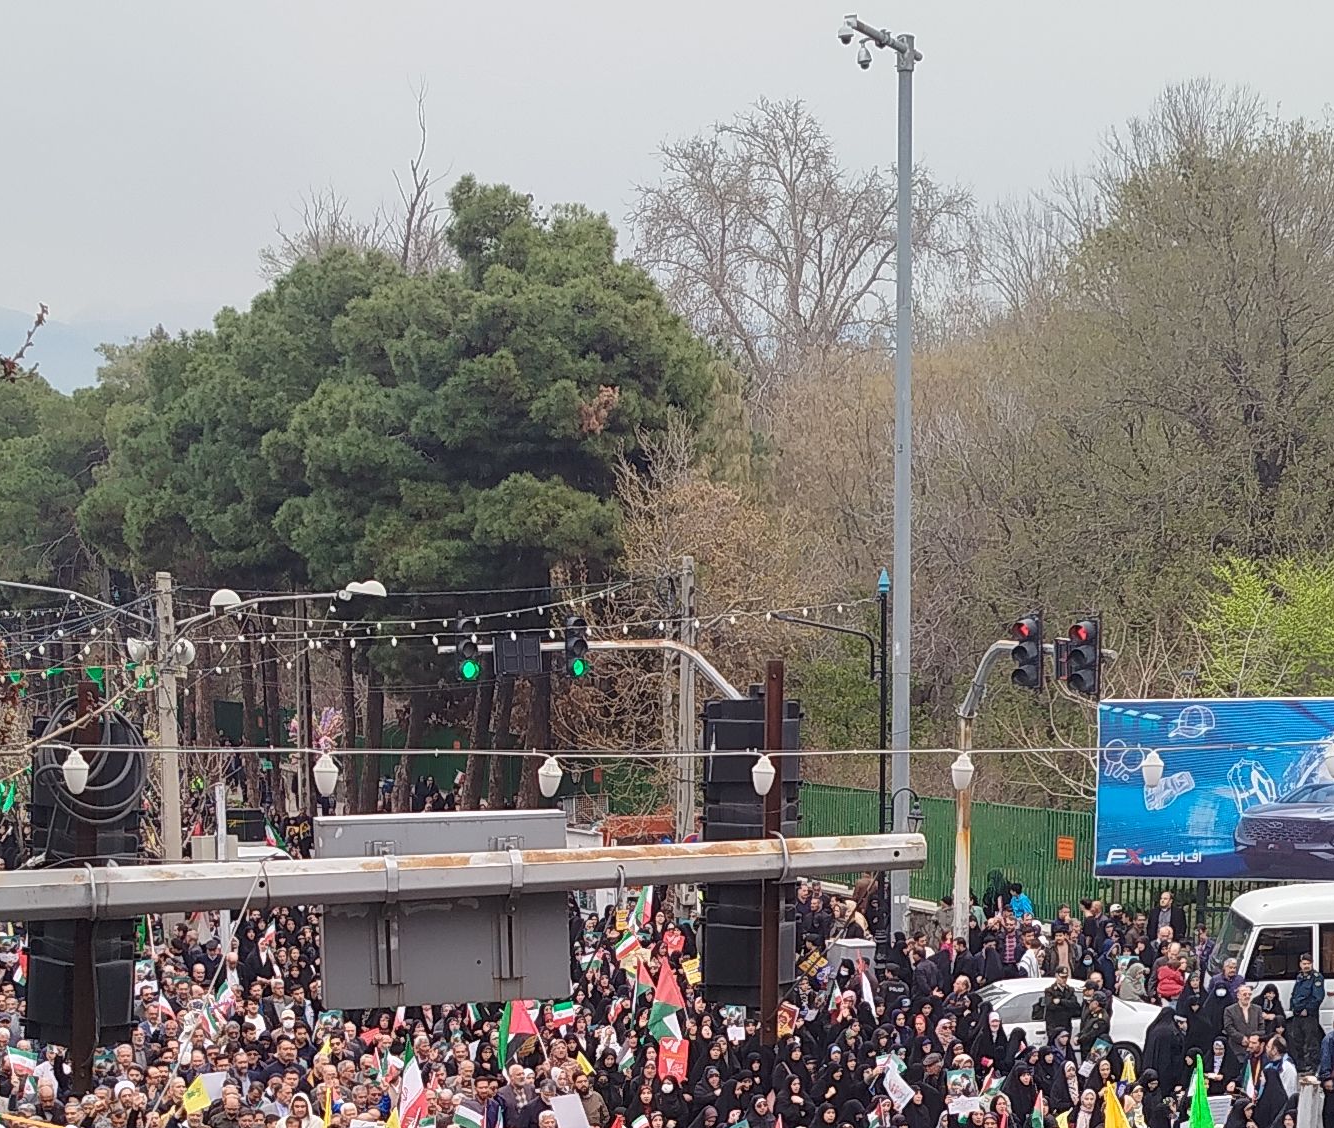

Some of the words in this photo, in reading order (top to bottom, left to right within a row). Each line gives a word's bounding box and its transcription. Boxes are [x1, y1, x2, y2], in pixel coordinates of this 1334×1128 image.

[1106, 847, 1144, 865] FX
[1143, 851, 1184, 866] ایکس
[1185, 849, 1202, 863] اف
